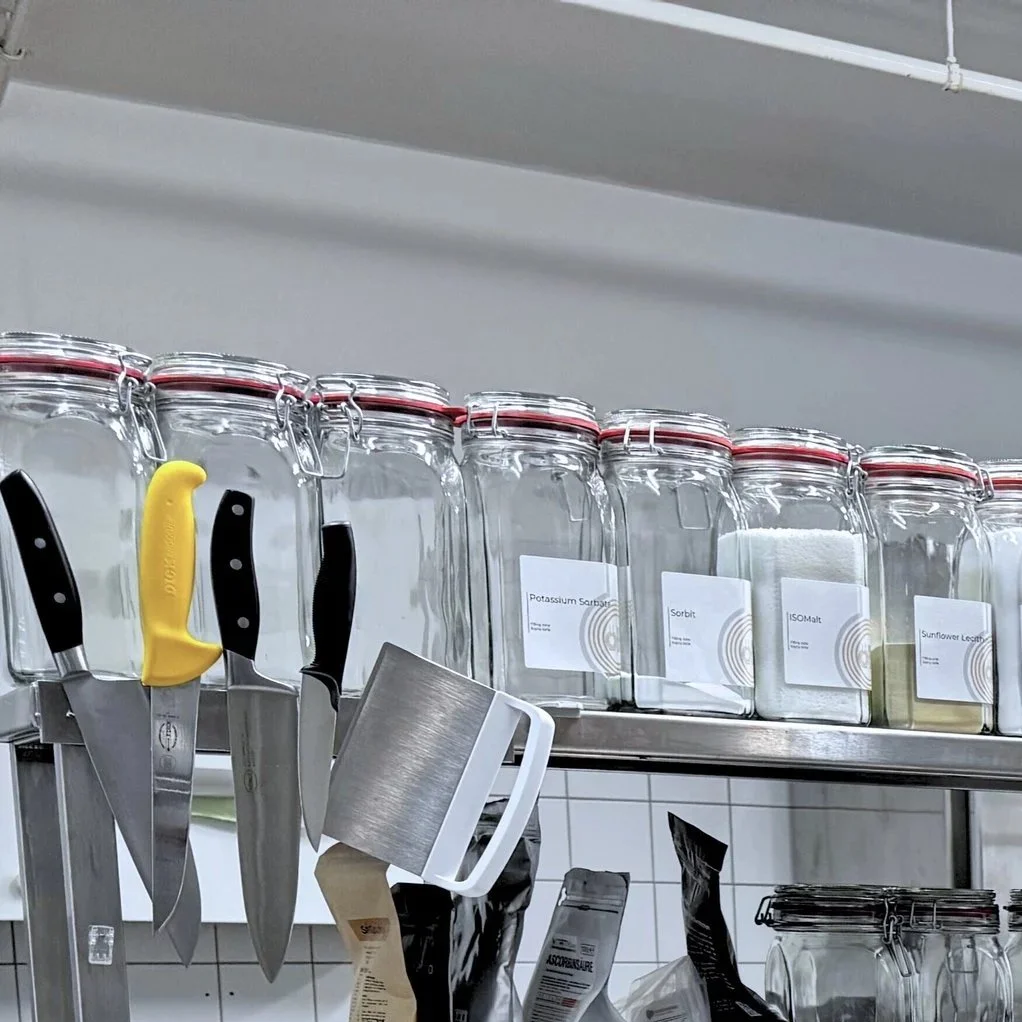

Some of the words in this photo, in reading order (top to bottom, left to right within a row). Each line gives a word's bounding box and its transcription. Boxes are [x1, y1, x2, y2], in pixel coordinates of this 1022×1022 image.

[529, 593, 577, 605] Potassium
[670, 608, 696, 619] Sorbit
[789, 613, 822, 624] ISOMalt
[921, 630, 960, 641] Sunflower
